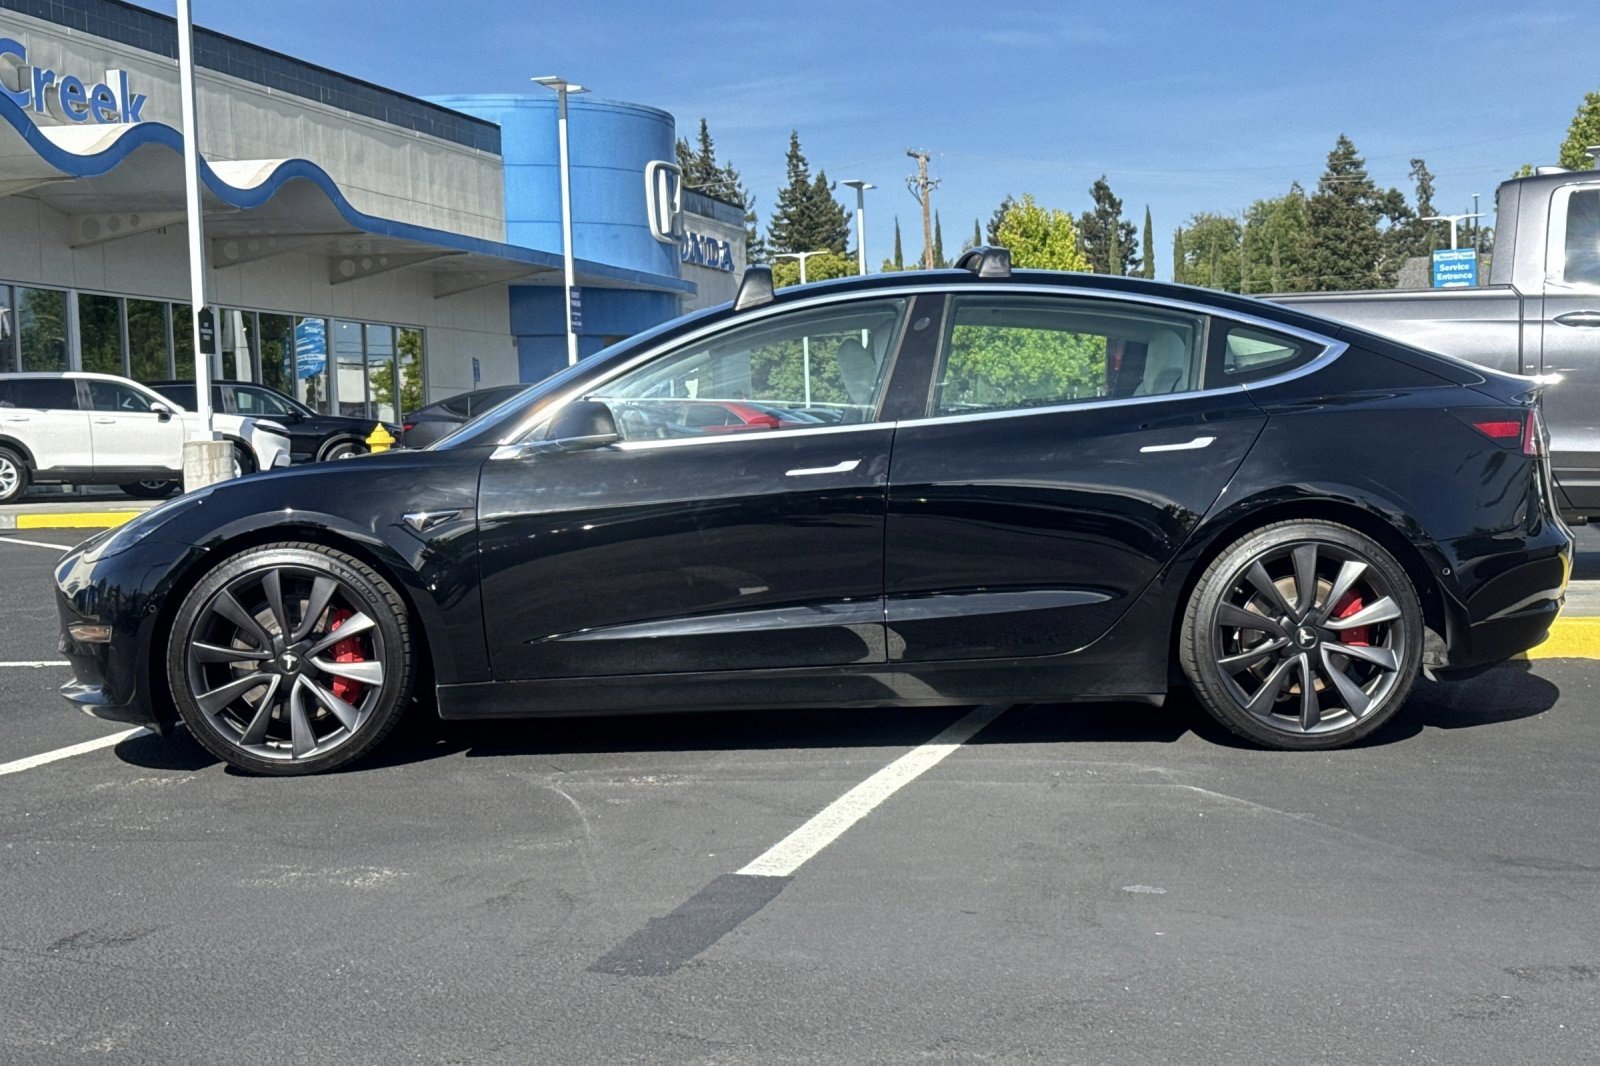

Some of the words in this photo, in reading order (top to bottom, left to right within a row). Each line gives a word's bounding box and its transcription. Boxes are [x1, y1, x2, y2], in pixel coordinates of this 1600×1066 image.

[0, 37, 148, 123] Creek
[681, 231, 735, 271] ONDA
[1437, 272, 1473, 280] Entrance
[1439, 262, 1470, 271] Service
